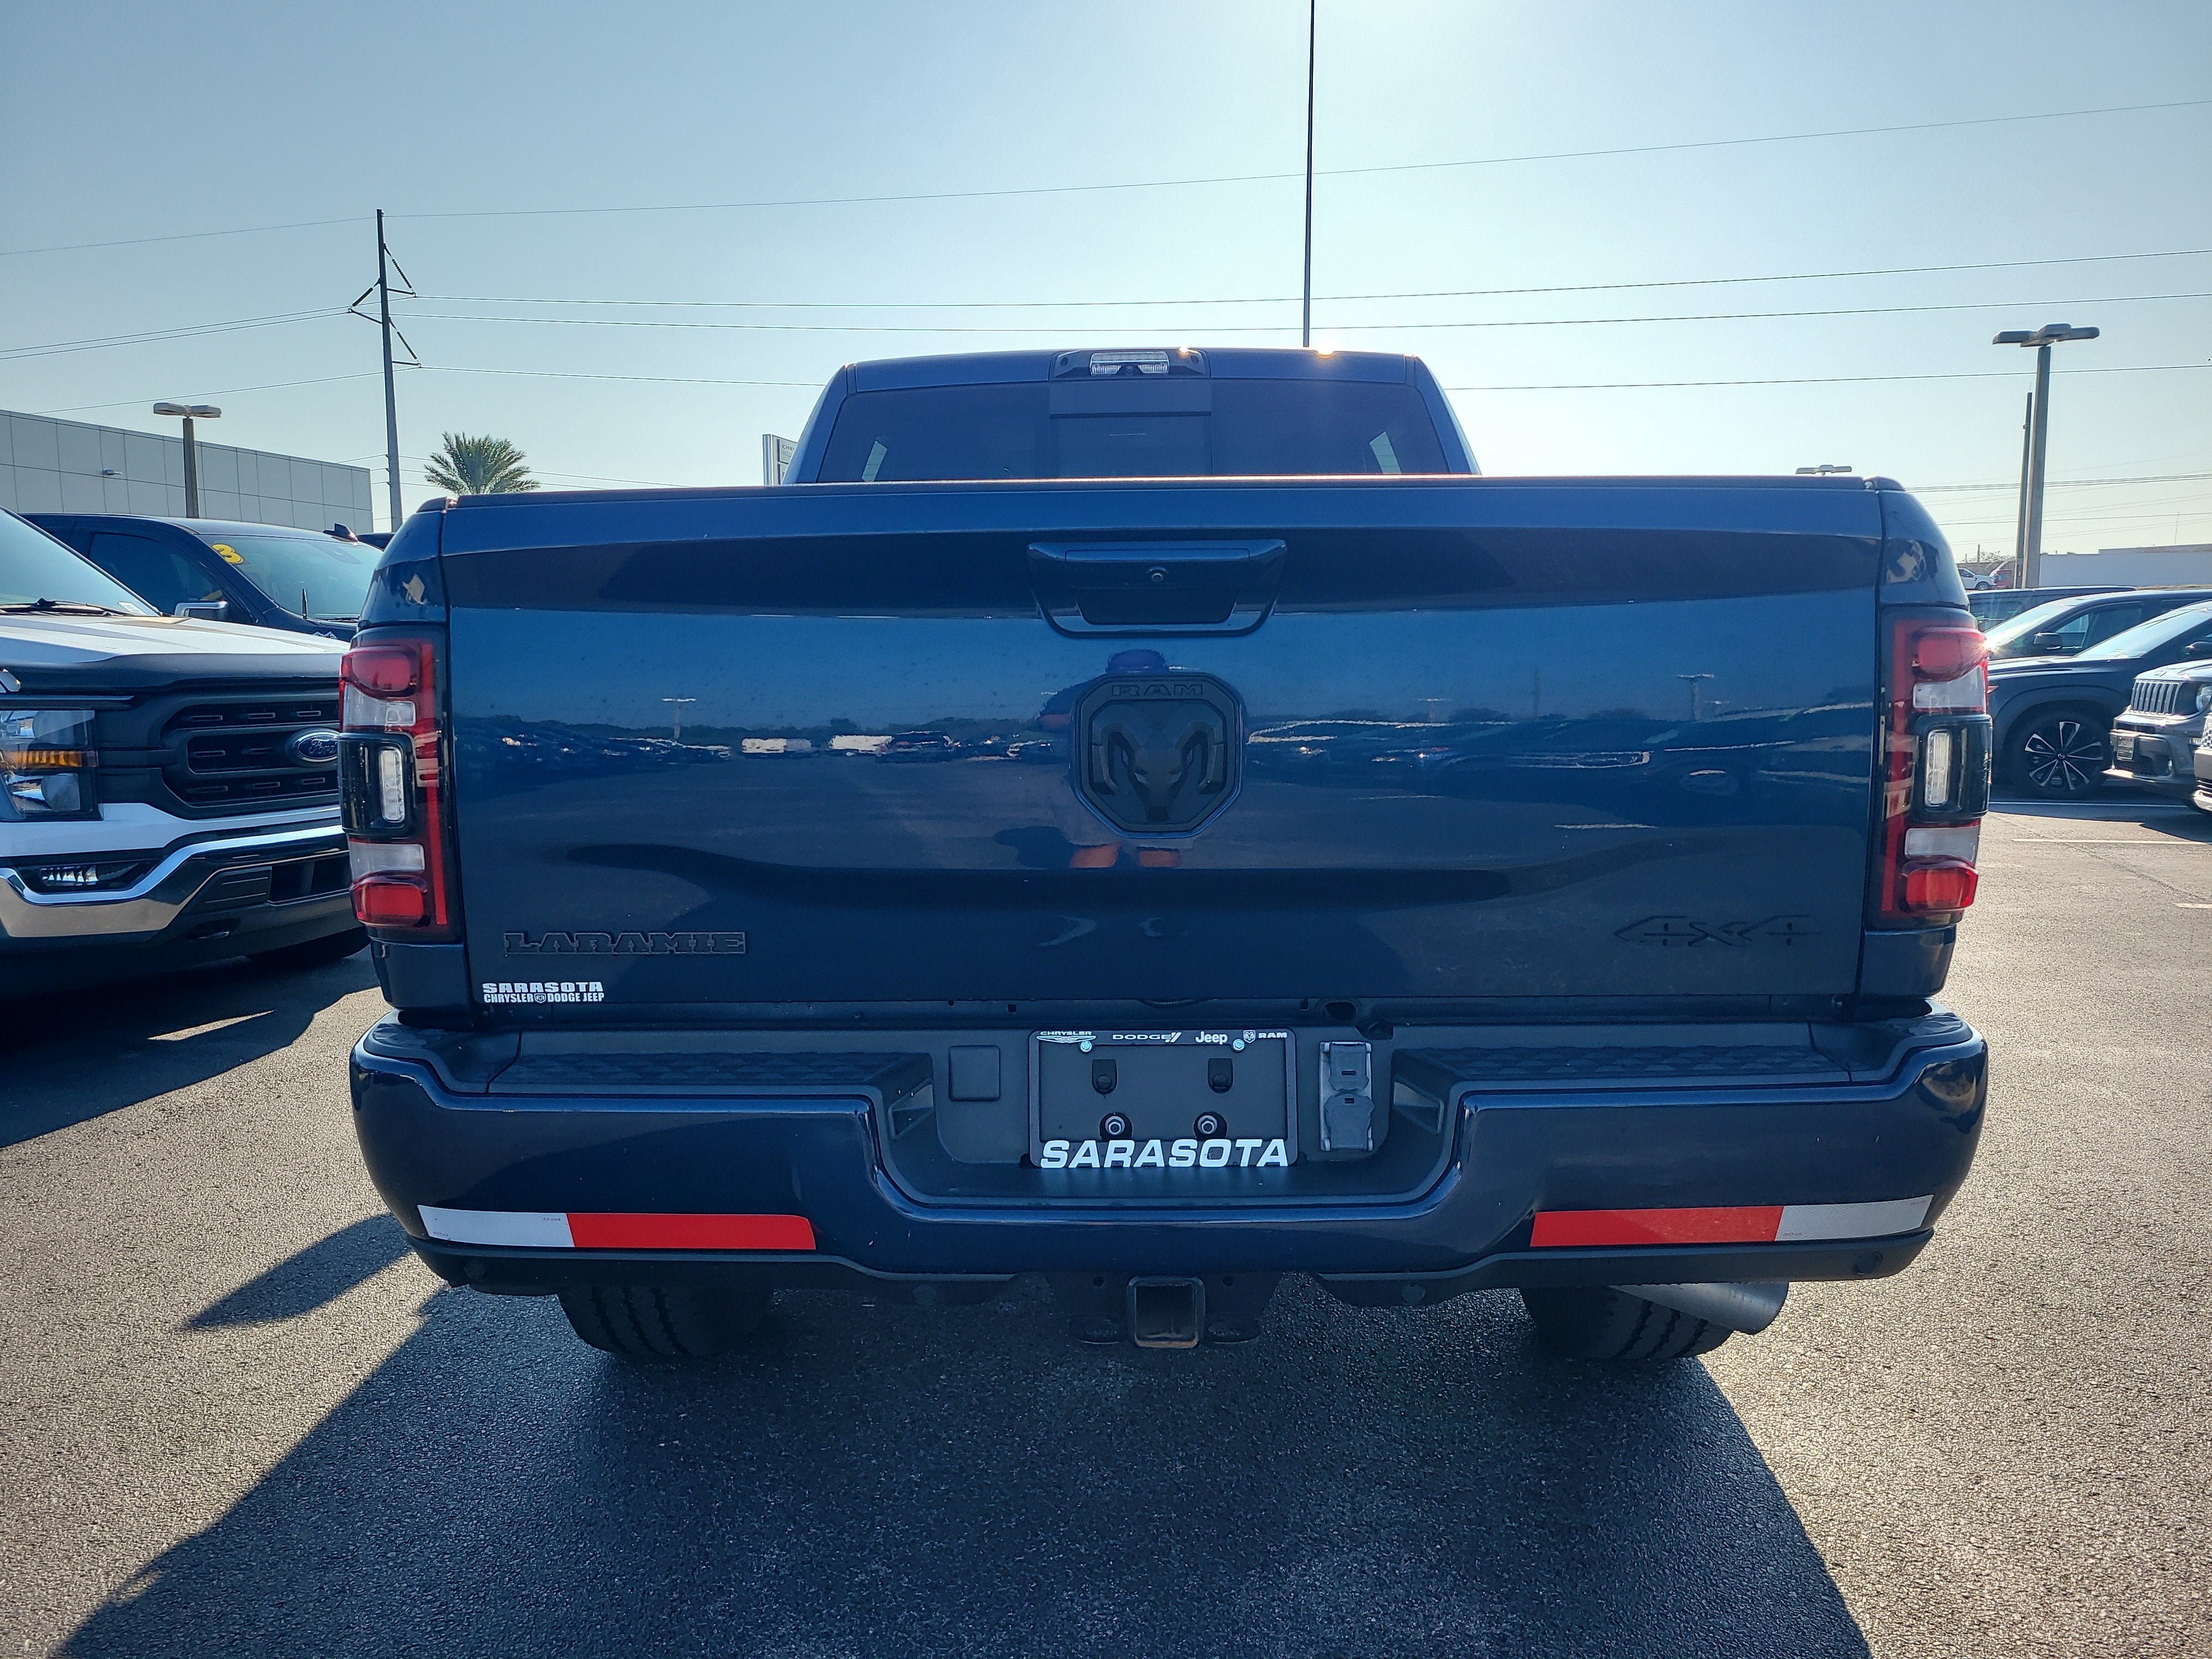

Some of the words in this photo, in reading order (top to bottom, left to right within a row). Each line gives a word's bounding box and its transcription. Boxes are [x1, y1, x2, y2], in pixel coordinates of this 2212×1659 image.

[1111, 684, 1203, 696] RAM
[504, 932, 746, 955] LARAMIE
[482, 981, 603, 993] SARASOTA
[484, 993, 534, 1003] CHRYSLER
[548, 992, 580, 1002] DODGE
[583, 992, 605, 1002] JEEP
[1195, 1031, 1228, 1045] Jeep
[1040, 1139, 1288, 1169] SARASOTA
